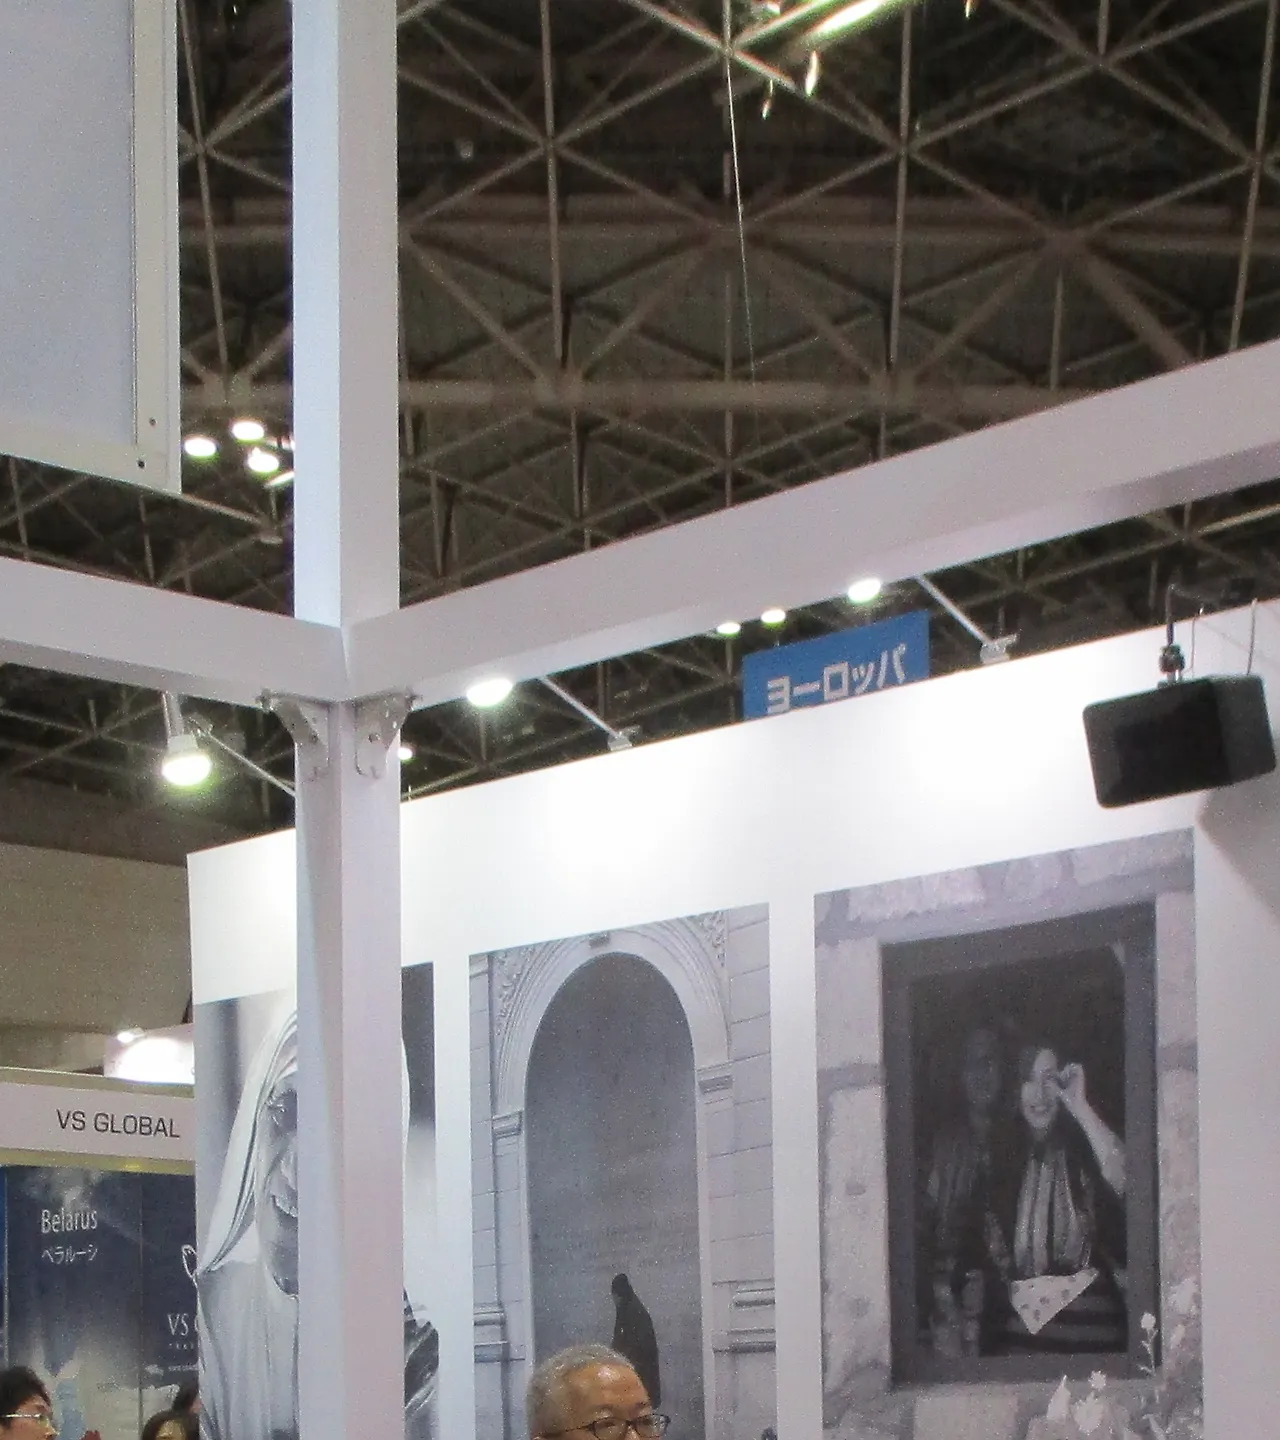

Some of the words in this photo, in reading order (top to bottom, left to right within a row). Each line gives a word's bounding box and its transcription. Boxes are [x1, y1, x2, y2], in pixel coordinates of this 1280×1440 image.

[767, 643, 907, 714] ヨーロッパ
[56, 1109, 86, 1132] VS
[93, 1112, 181, 1138] GLOBAL
[41, 1208, 98, 1234] Belarus
[41, 1244, 98, 1265] ベラルーシ
[167, 1312, 190, 1336] VS
